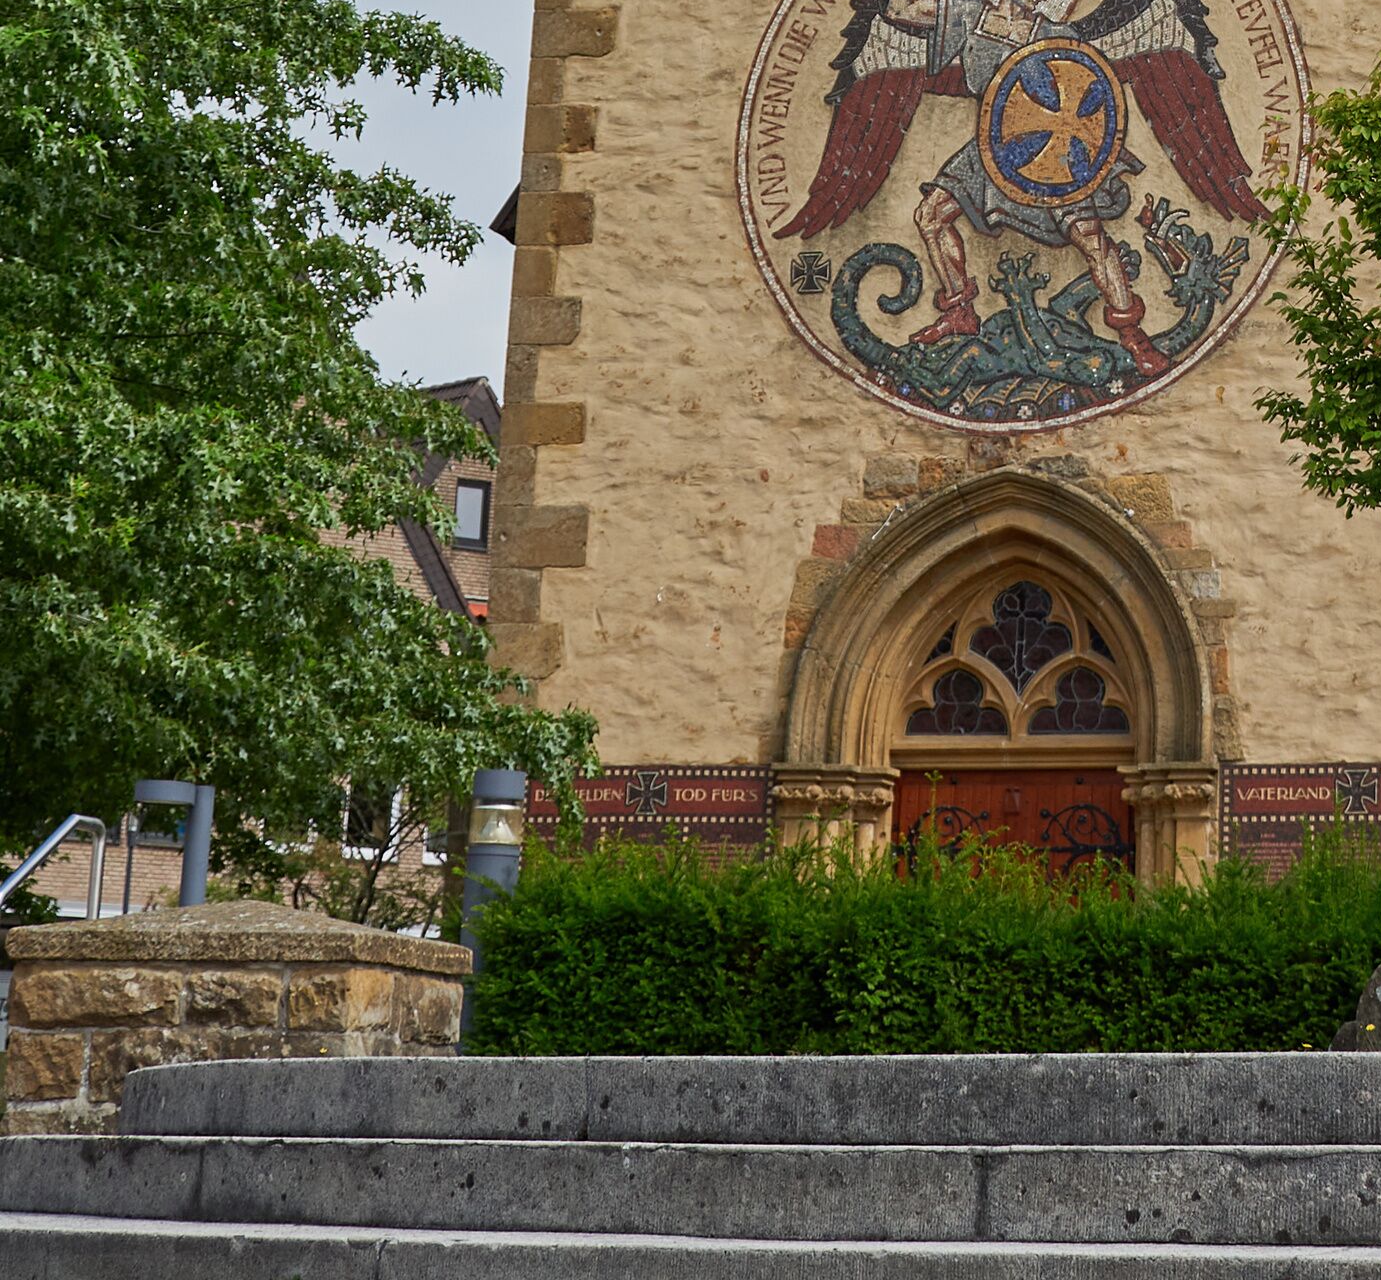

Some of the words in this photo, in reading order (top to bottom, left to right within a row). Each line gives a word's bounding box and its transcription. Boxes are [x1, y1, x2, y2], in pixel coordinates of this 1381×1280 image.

[785, 19, 819, 65] DIE
[757, 62, 798, 151] WENN
[757, 152, 791, 229] VND
[674, 788, 706, 802] TOD
[1237, 786, 1331, 801] VATERLAND
